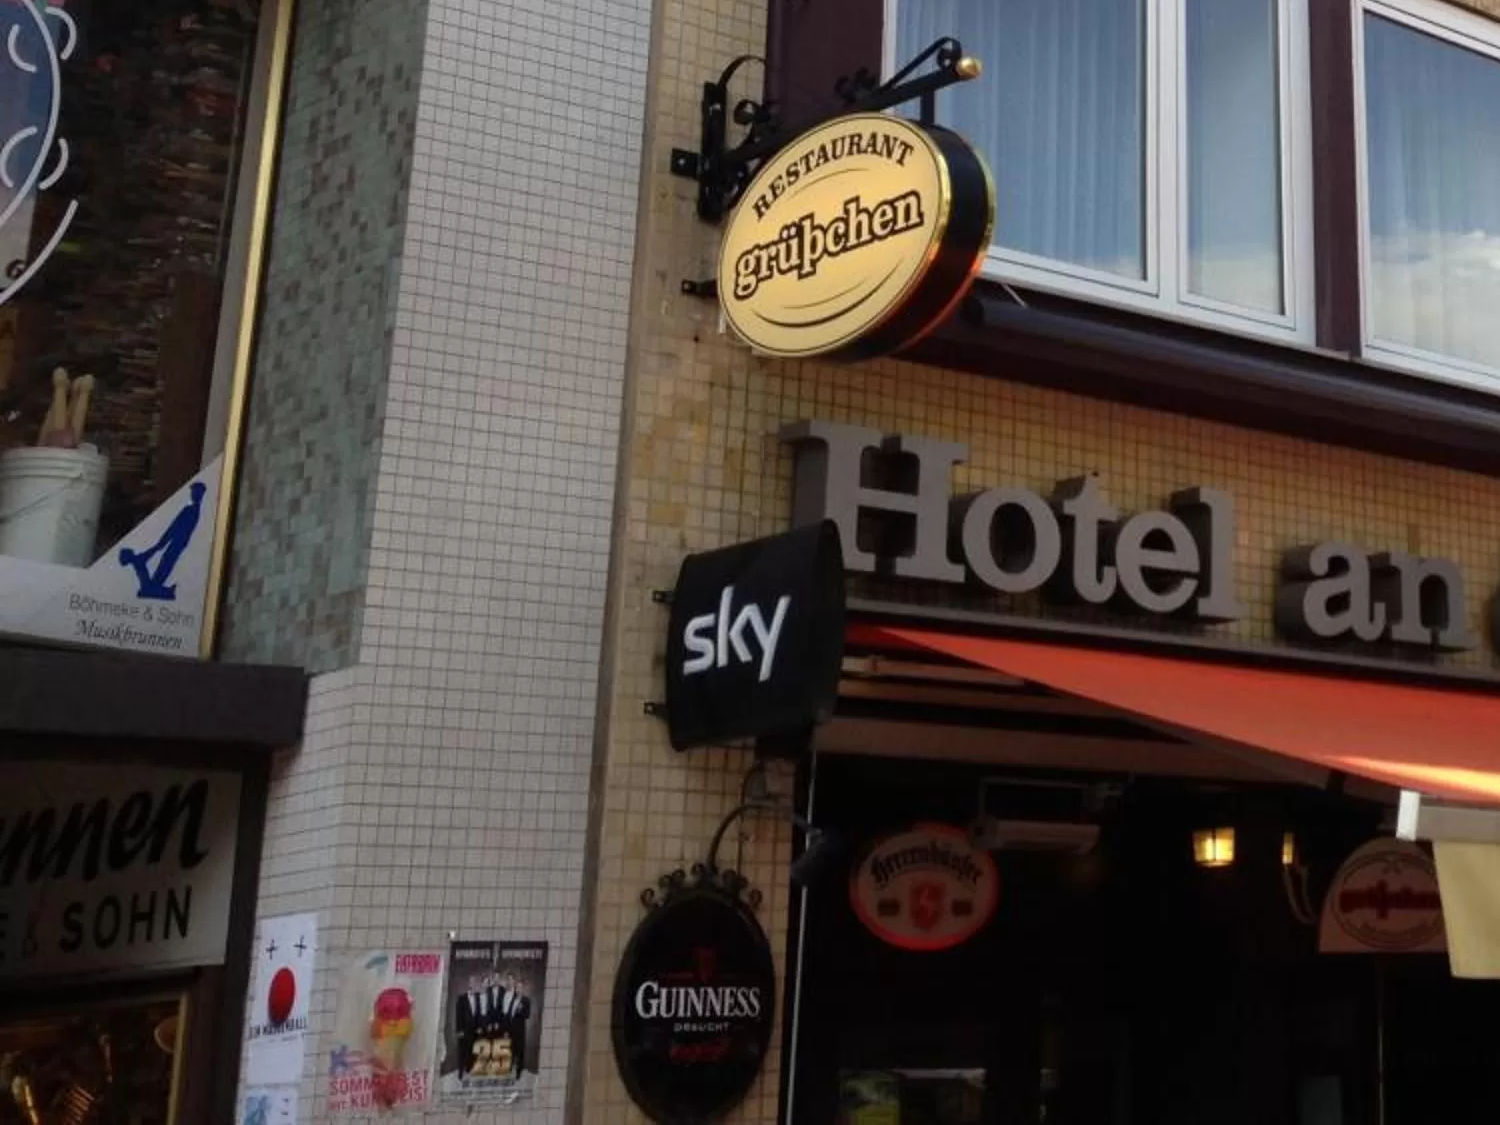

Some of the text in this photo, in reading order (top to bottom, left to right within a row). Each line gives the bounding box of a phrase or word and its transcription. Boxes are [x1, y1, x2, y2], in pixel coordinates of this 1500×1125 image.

[752, 131, 914, 221] RESTAURANT
[798, 419, 1248, 623] Hotel
[157, 605, 196, 628] Sohn
[683, 585, 792, 683] sky
[1296, 539, 1478, 652] an
[59, 884, 193, 953] SOHN
[635, 979, 762, 1019] GUINNESS
[470, 1038, 513, 1077] 25
